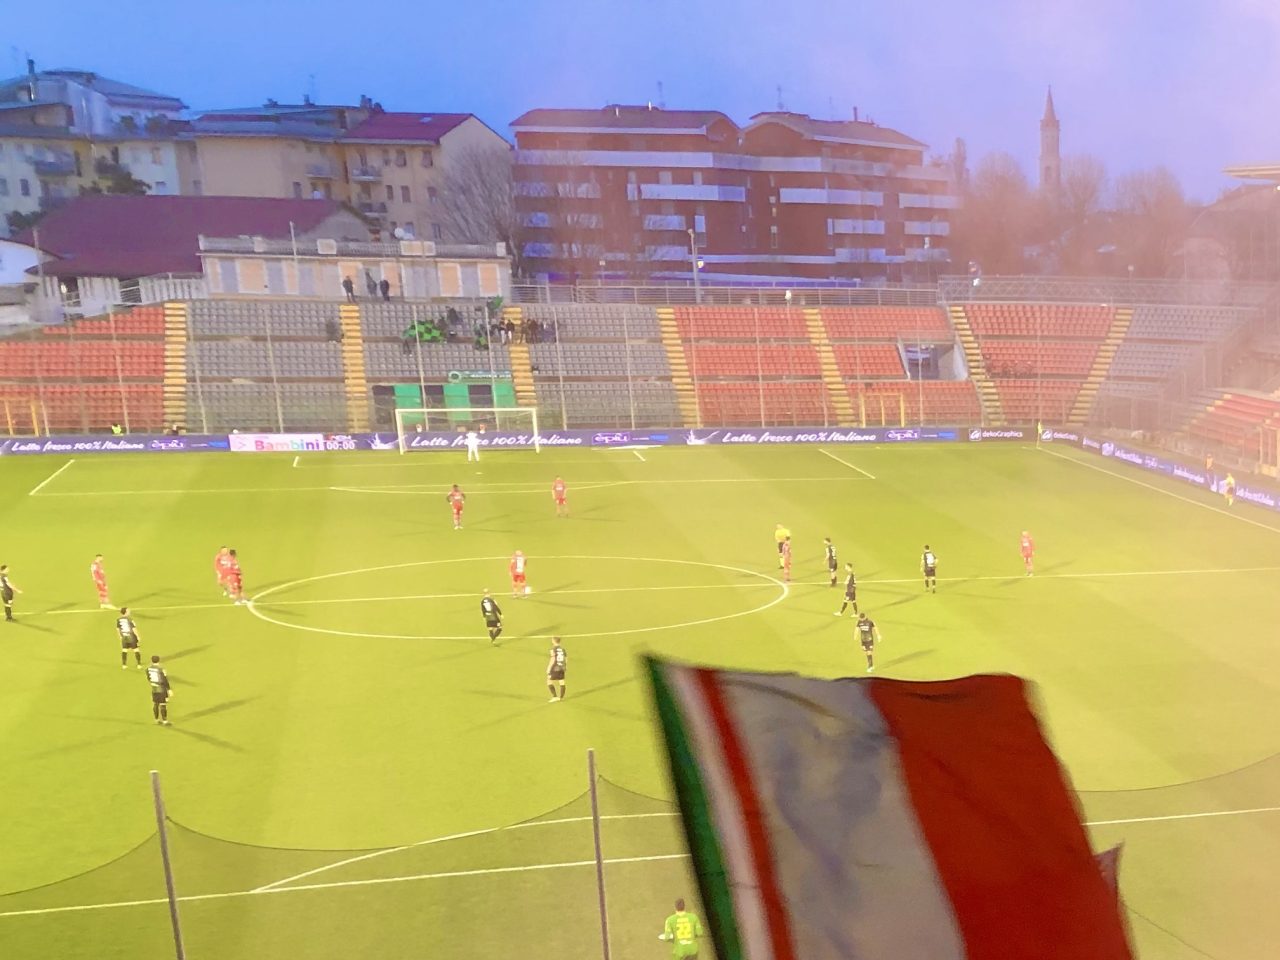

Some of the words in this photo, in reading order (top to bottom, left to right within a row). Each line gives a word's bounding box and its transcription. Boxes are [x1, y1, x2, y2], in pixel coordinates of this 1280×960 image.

[411, 436, 449, 447] Latte
[492, 435, 526, 445] 100%
[722, 432, 757, 443] Latte
[758, 432, 793, 443] fresco
[795, 432, 827, 442] 100%
[254, 439, 320, 451] Bambini
